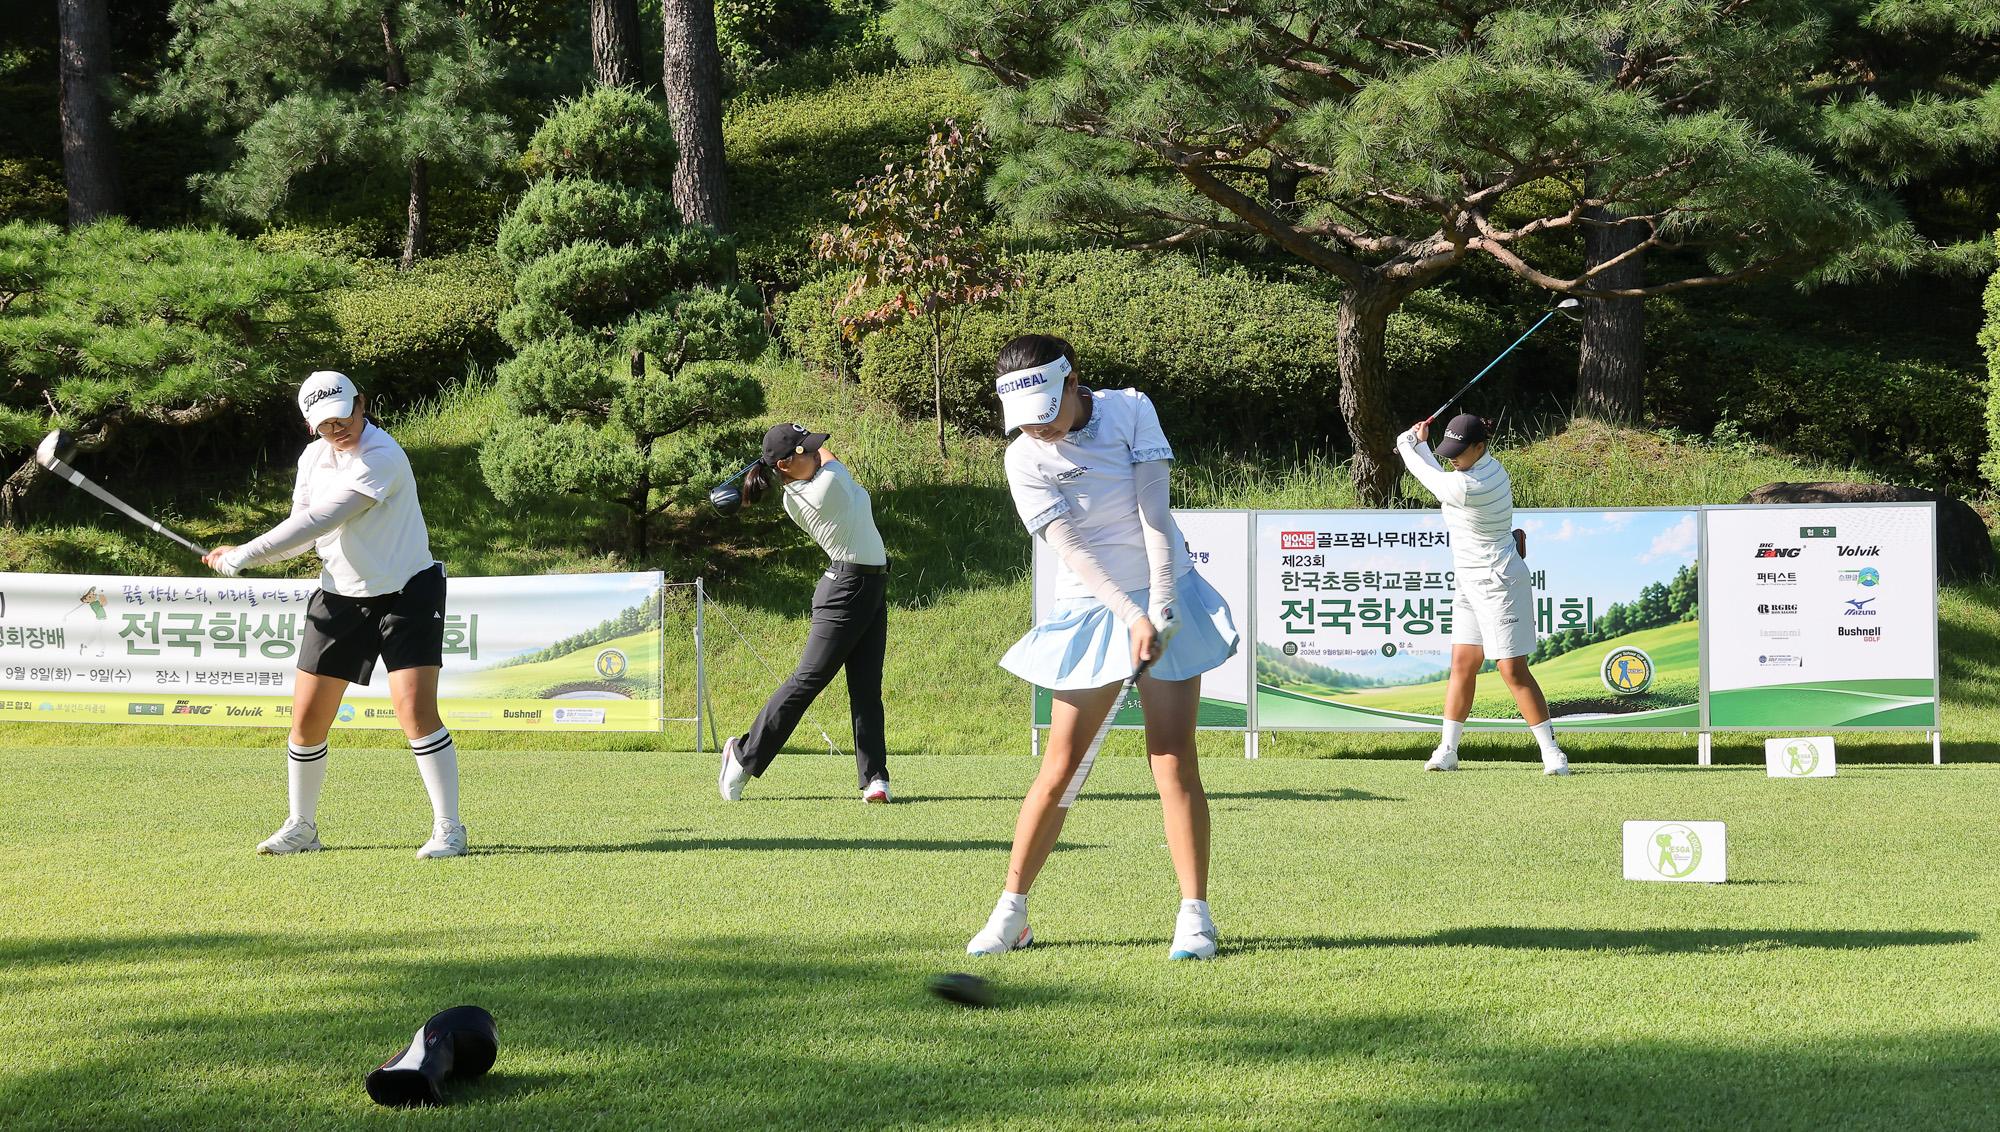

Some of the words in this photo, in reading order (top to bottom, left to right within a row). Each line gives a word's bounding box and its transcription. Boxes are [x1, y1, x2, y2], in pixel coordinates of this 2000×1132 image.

[304, 386, 342, 412] Titleist
[1282, 533, 1315, 549] 일요신문
[1317, 532, 1450, 548] 골프꿈나무대잔치
[1837, 546, 1880, 556] Volvik
[1282, 555, 1325, 567] 제23회
[1757, 572, 1796, 583] 퍼티스트
[123, 585, 145, 605] 꿈을
[148, 588, 178, 602] 향한
[218, 586, 258, 607] 미래를
[263, 591, 289, 602] 여는
[1838, 627, 1880, 636] Bushnell
[6, 666, 25, 680] 9월
[30, 667, 72, 682] 8일(화)
[90, 668, 132, 683] 9일(수)
[155, 670, 181, 684] 장소
[194, 671, 283, 685] 보성컨트리클럽
[225, 706, 263, 716] Volvik
[503, 709, 542, 718] Bushnell
